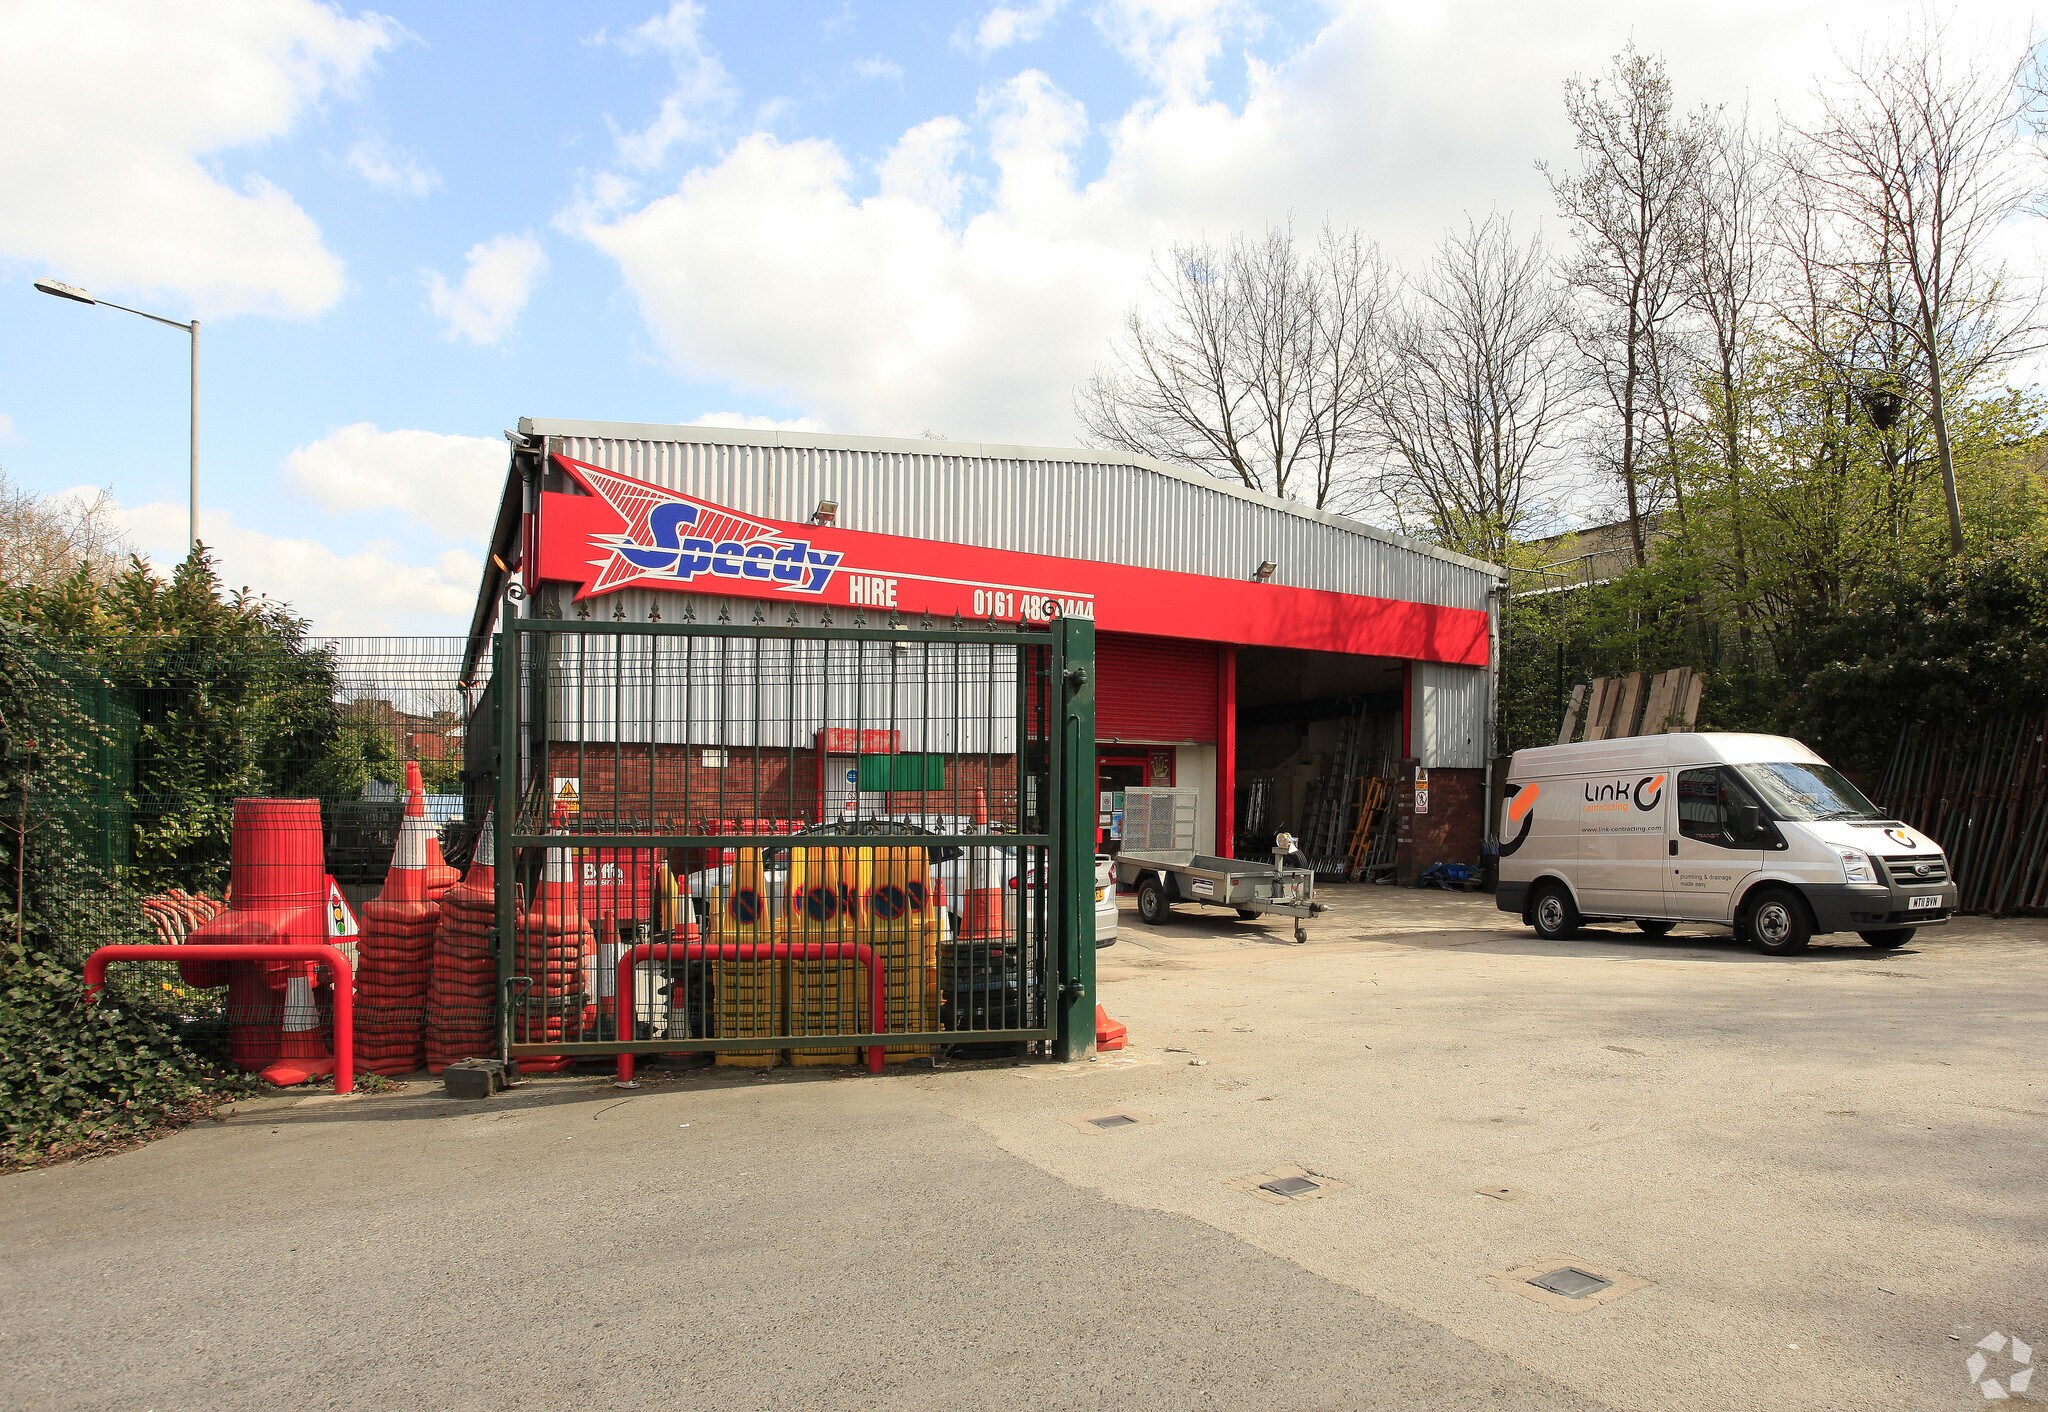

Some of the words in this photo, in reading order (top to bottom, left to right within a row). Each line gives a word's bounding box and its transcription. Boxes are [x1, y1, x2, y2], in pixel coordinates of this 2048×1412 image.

[617, 502, 844, 594] Speedy
[849, 575, 898, 607] HIRE
[973, 589, 1014, 618] 0161
[1582, 802, 1629, 813] contracting
[1581, 825, 1662, 833] www.link-contracting.com
